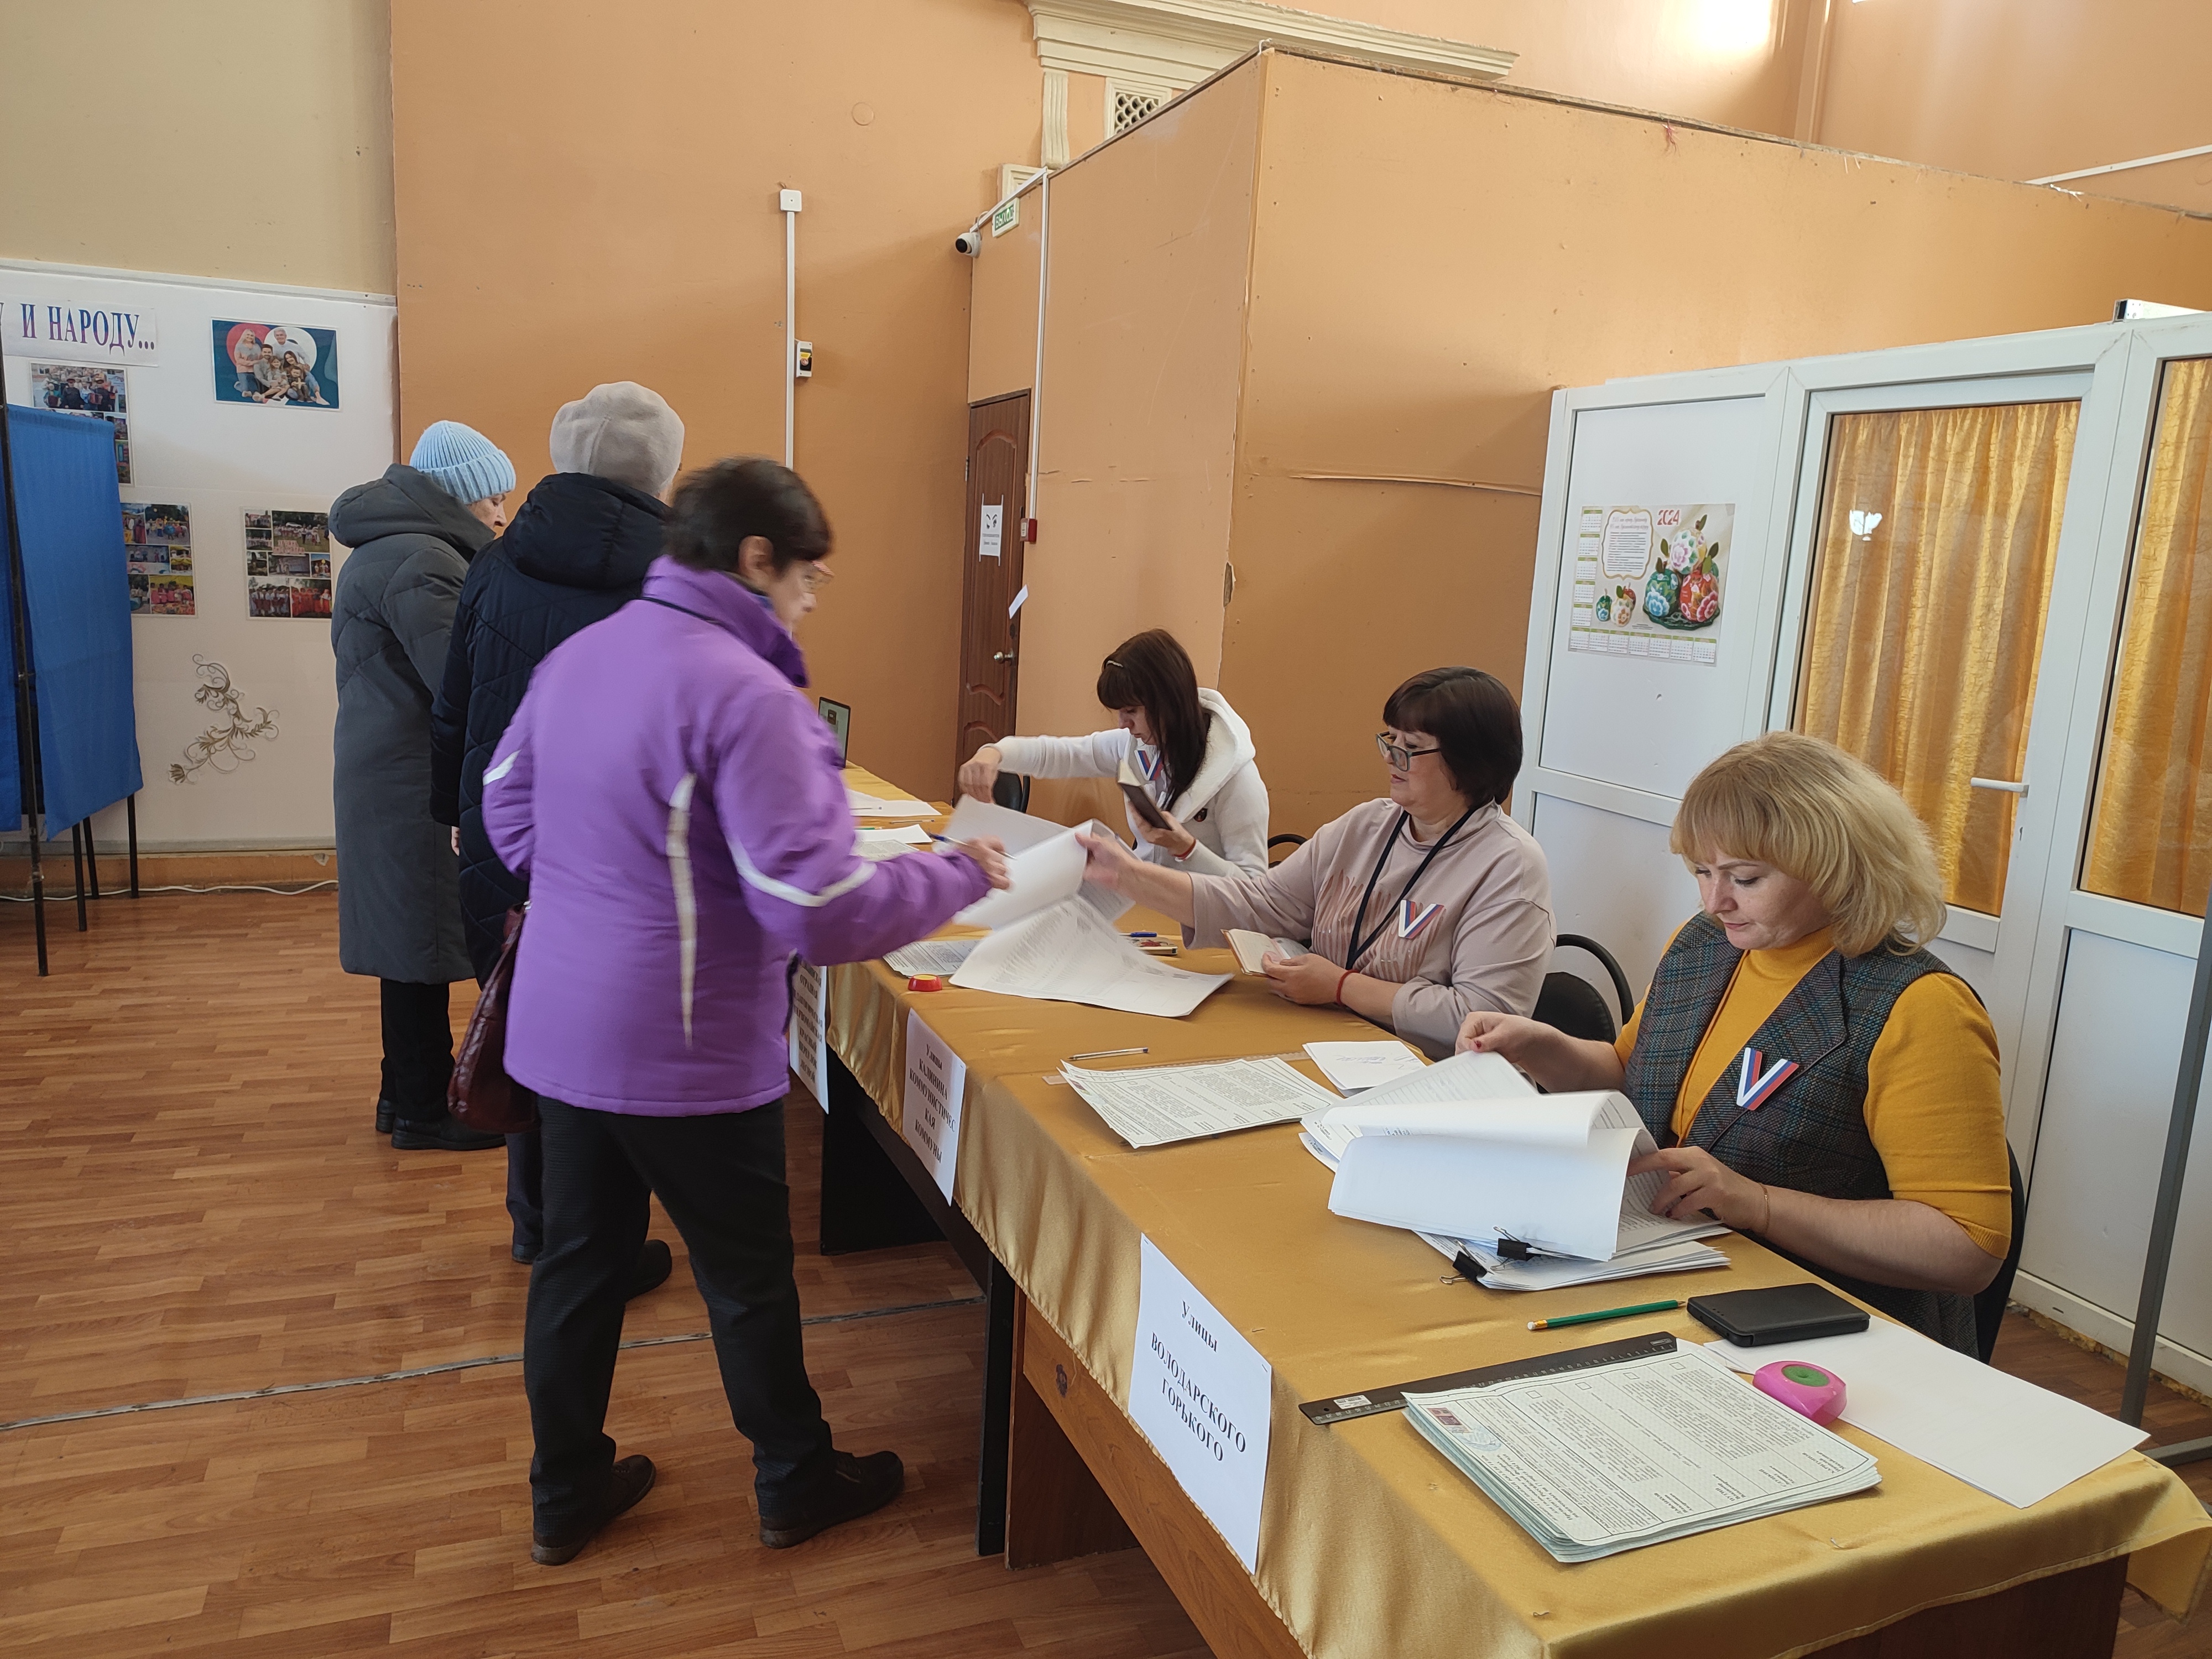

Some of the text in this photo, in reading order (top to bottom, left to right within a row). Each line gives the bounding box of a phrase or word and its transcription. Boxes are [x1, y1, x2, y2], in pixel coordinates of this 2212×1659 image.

[995, 207, 1014, 228] ВЫХОД
[20, 303, 37, 339] И
[47, 305, 154, 356] НАРОДУ...
[1657, 509, 1681, 526] 2024
[919, 1058, 948, 1100] КАЛИНИНА
[926, 1044, 943, 1071] Улицы
[910, 1068, 956, 1133] КОММУНИСТИЧЕС
[925, 1108, 936, 1131] КАЯ
[915, 1118, 942, 1164] КОММУНЫ
[1182, 1300, 1218, 1353] Улицы
[1151, 1331, 1246, 1454] ВОЛОДАРСКОГО
[1161, 1377, 1224, 1462] ГОРЬКОГО
